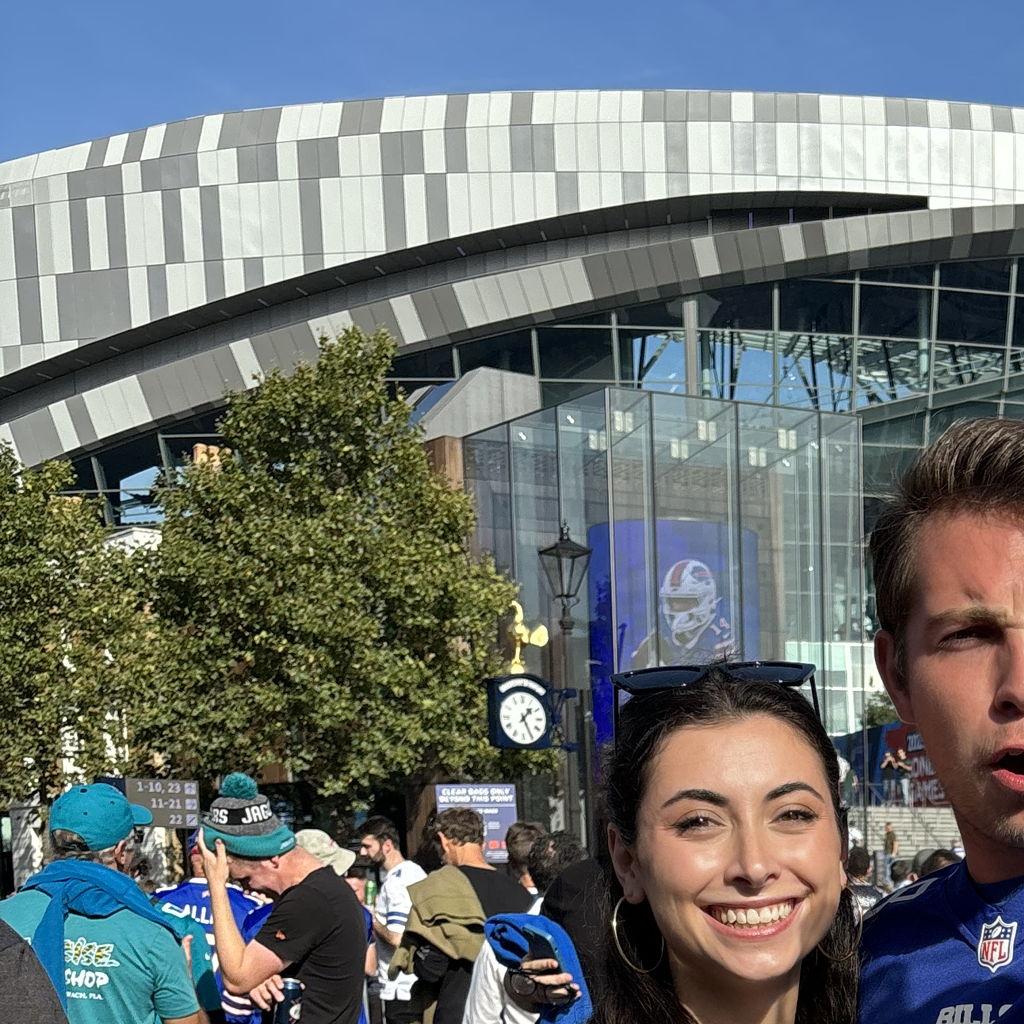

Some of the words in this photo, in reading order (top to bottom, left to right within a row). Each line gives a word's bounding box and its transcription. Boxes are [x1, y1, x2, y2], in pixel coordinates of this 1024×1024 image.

[137, 781, 165, 795] 1-10,
[168, 782, 181, 794] 23
[151, 798, 182, 809] 11-21
[169, 815, 183, 825] 22
[981, 940, 1006, 961] NFL
